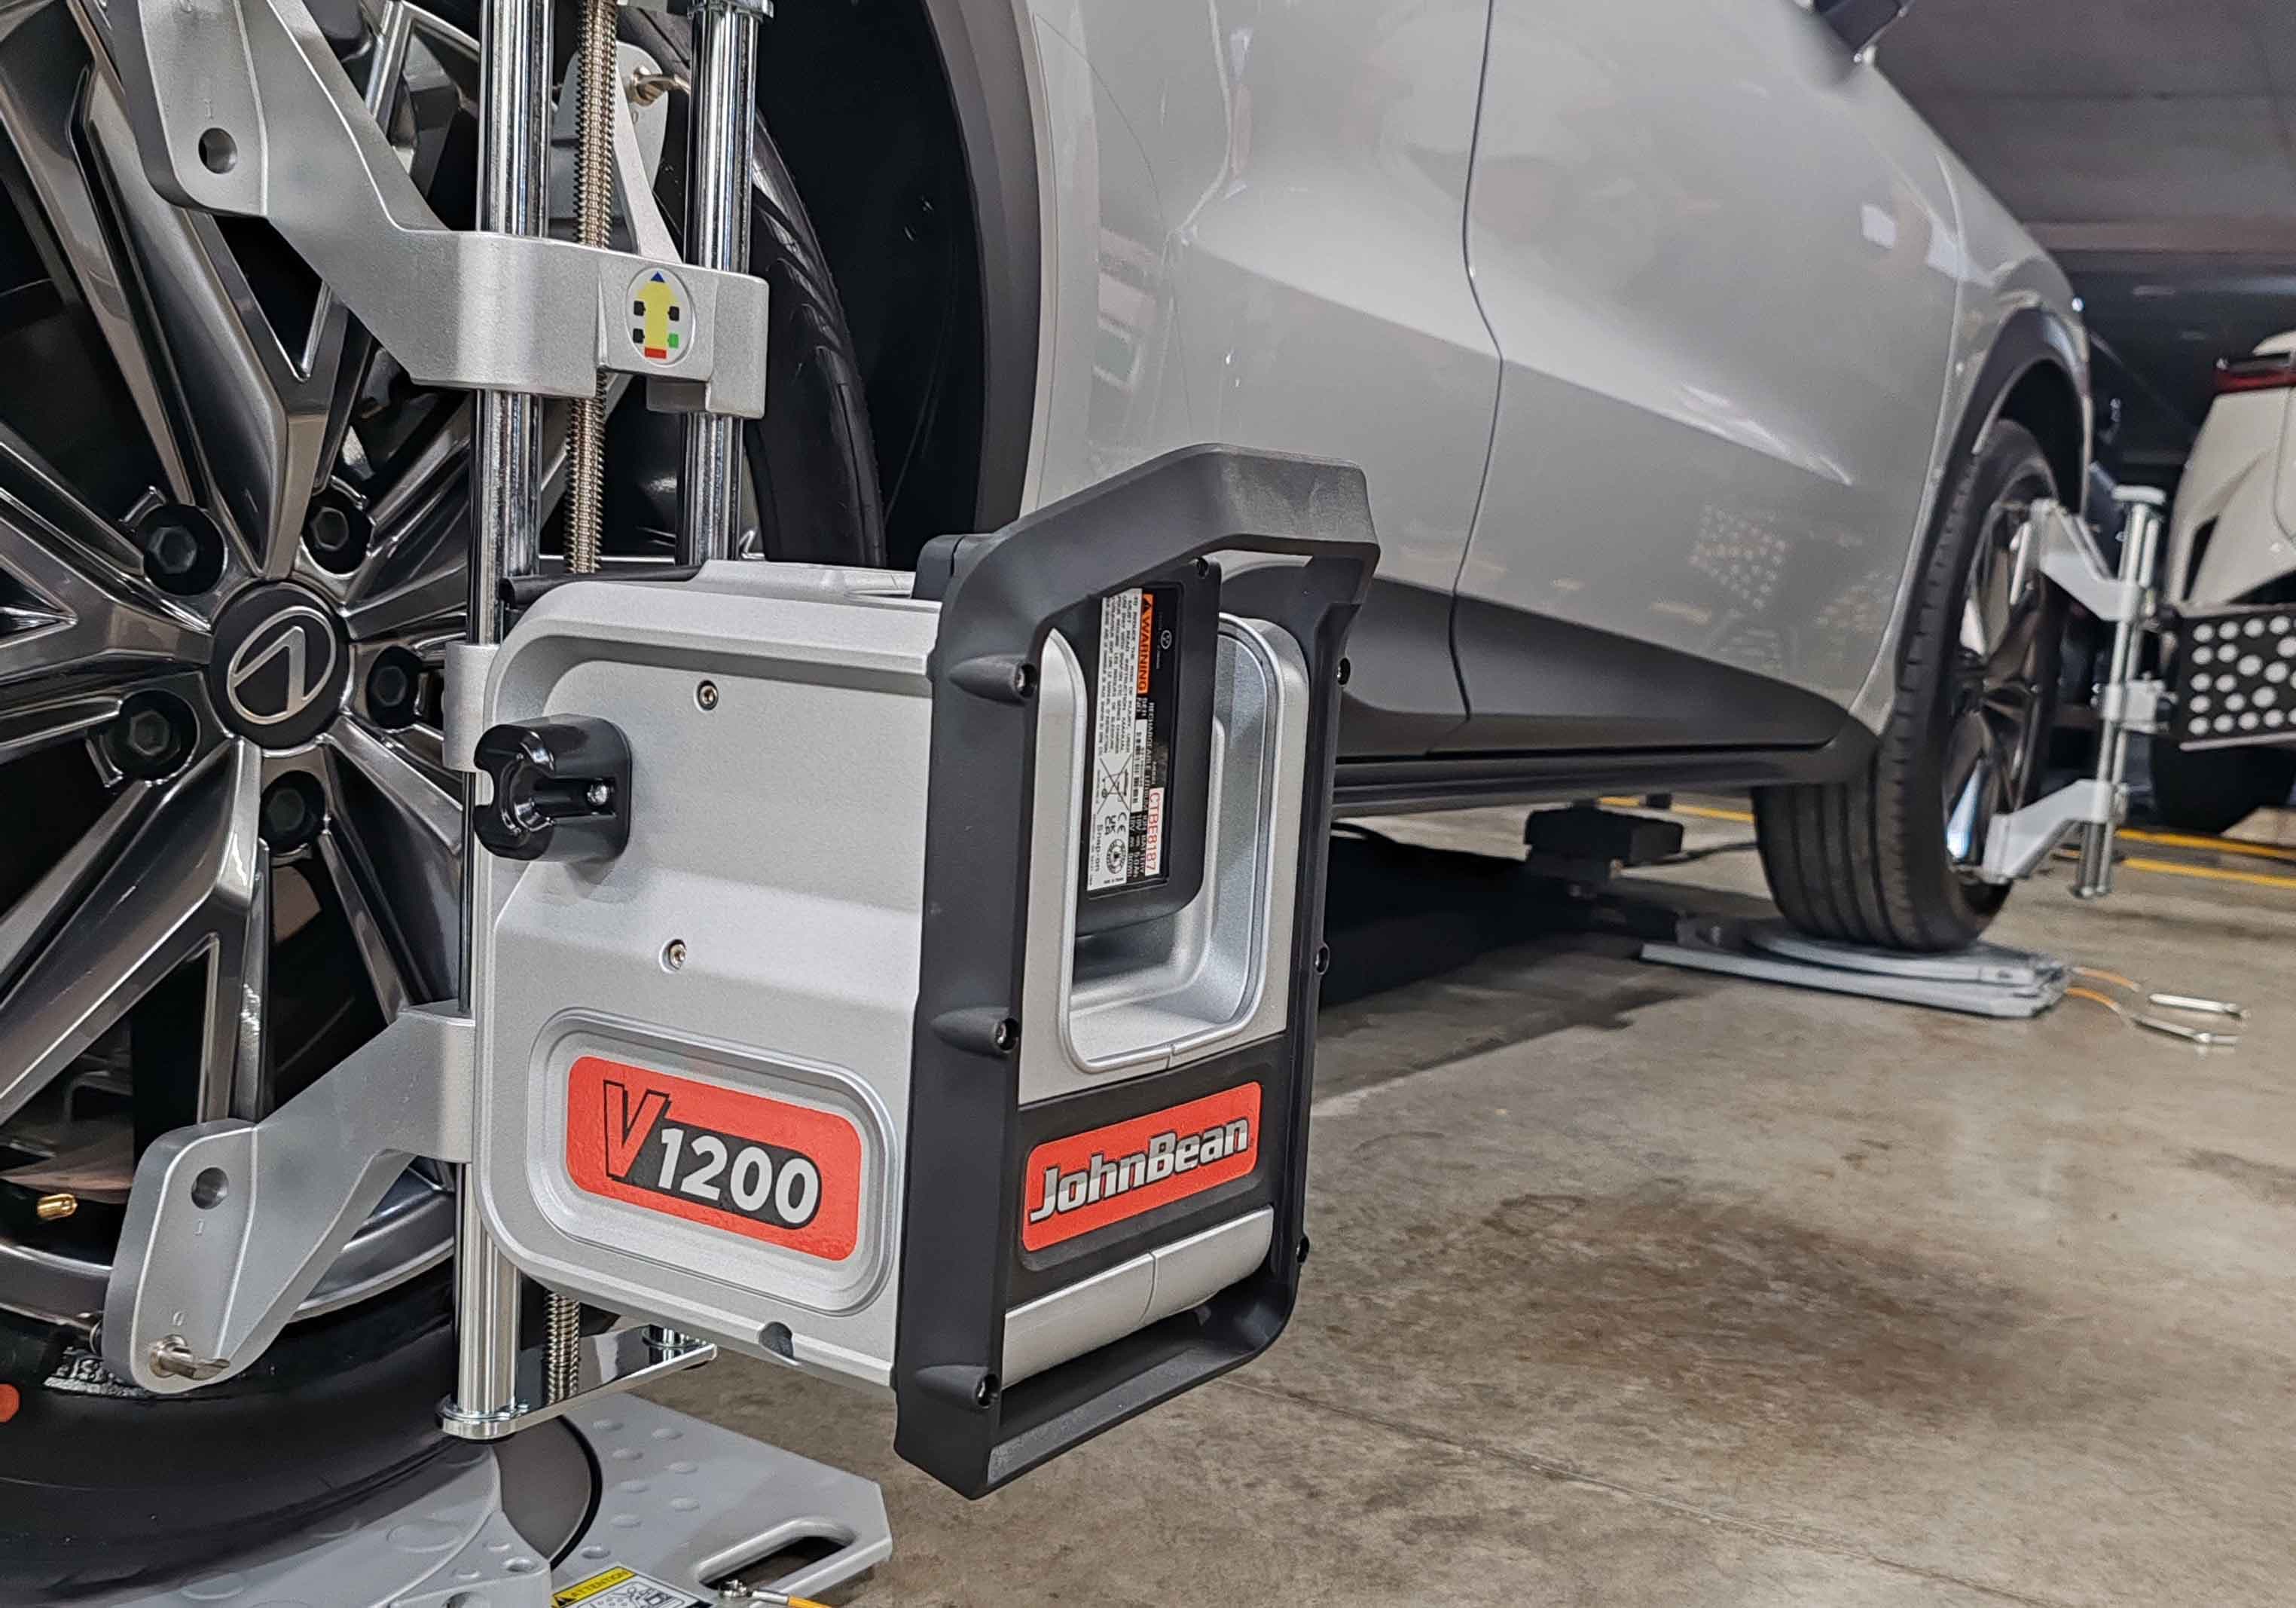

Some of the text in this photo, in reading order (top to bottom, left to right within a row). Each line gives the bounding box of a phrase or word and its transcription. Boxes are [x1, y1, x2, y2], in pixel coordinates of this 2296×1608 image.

[1137, 616, 1150, 689] WARNING
[1146, 792, 1161, 870] CTBE8187
[602, 1079, 820, 1224] V1200
[1027, 1117, 1250, 1224] JohnBean
[569, 1570, 630, 1597] ATTENTION
